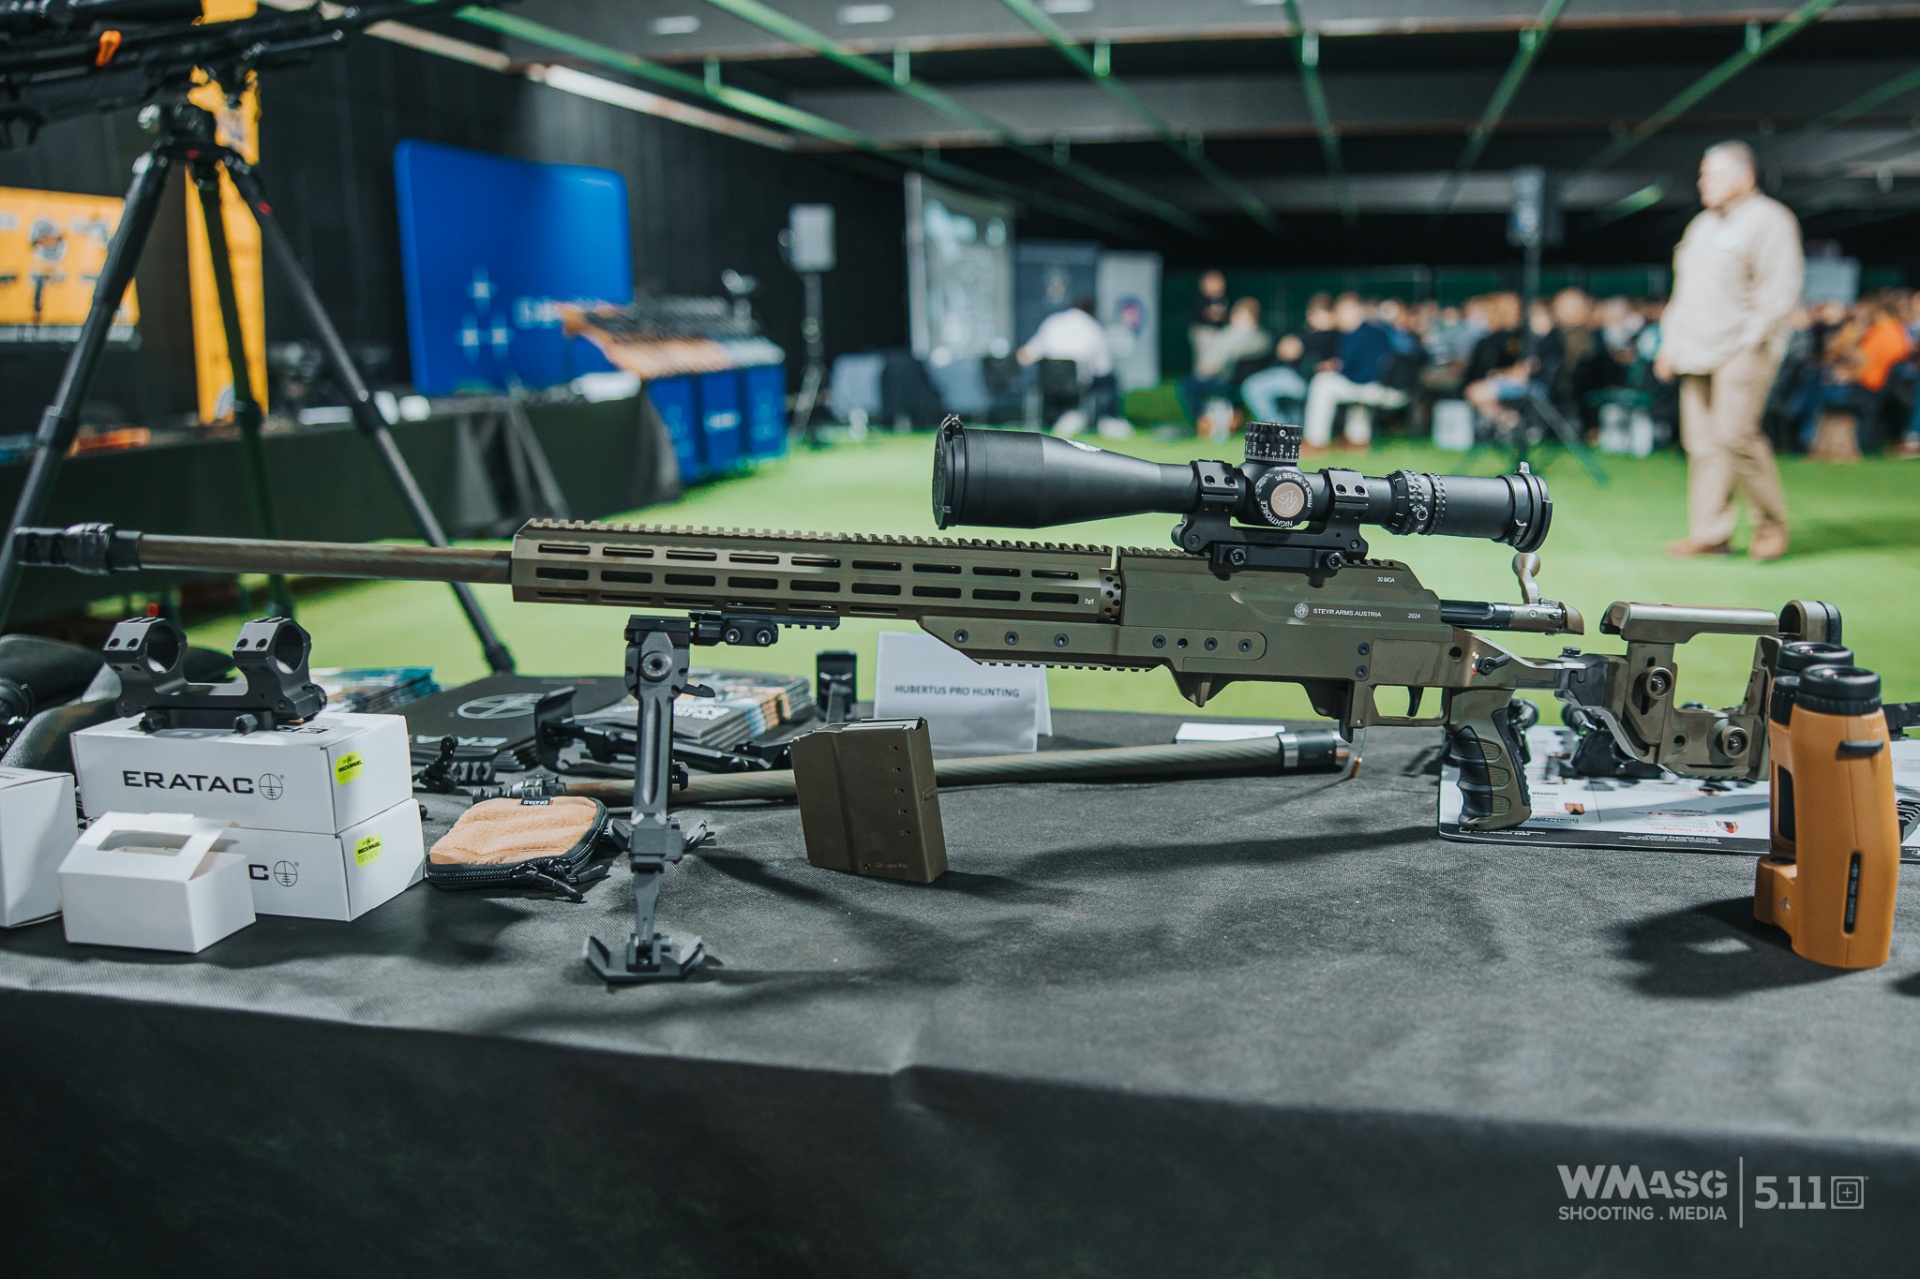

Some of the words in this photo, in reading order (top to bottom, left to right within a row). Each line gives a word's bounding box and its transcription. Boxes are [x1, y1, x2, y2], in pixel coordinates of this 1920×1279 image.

[1260, 500, 1293, 528] NIGHTFORCE
[1313, 608, 1335, 616] STEYR
[1354, 610, 1381, 618] AUSTRIA
[894, 685, 947, 696] HUBERTUS
[950, 686, 970, 697] PRO
[972, 687, 1020, 698] HUNTING
[122, 770, 254, 795] ERATAC
